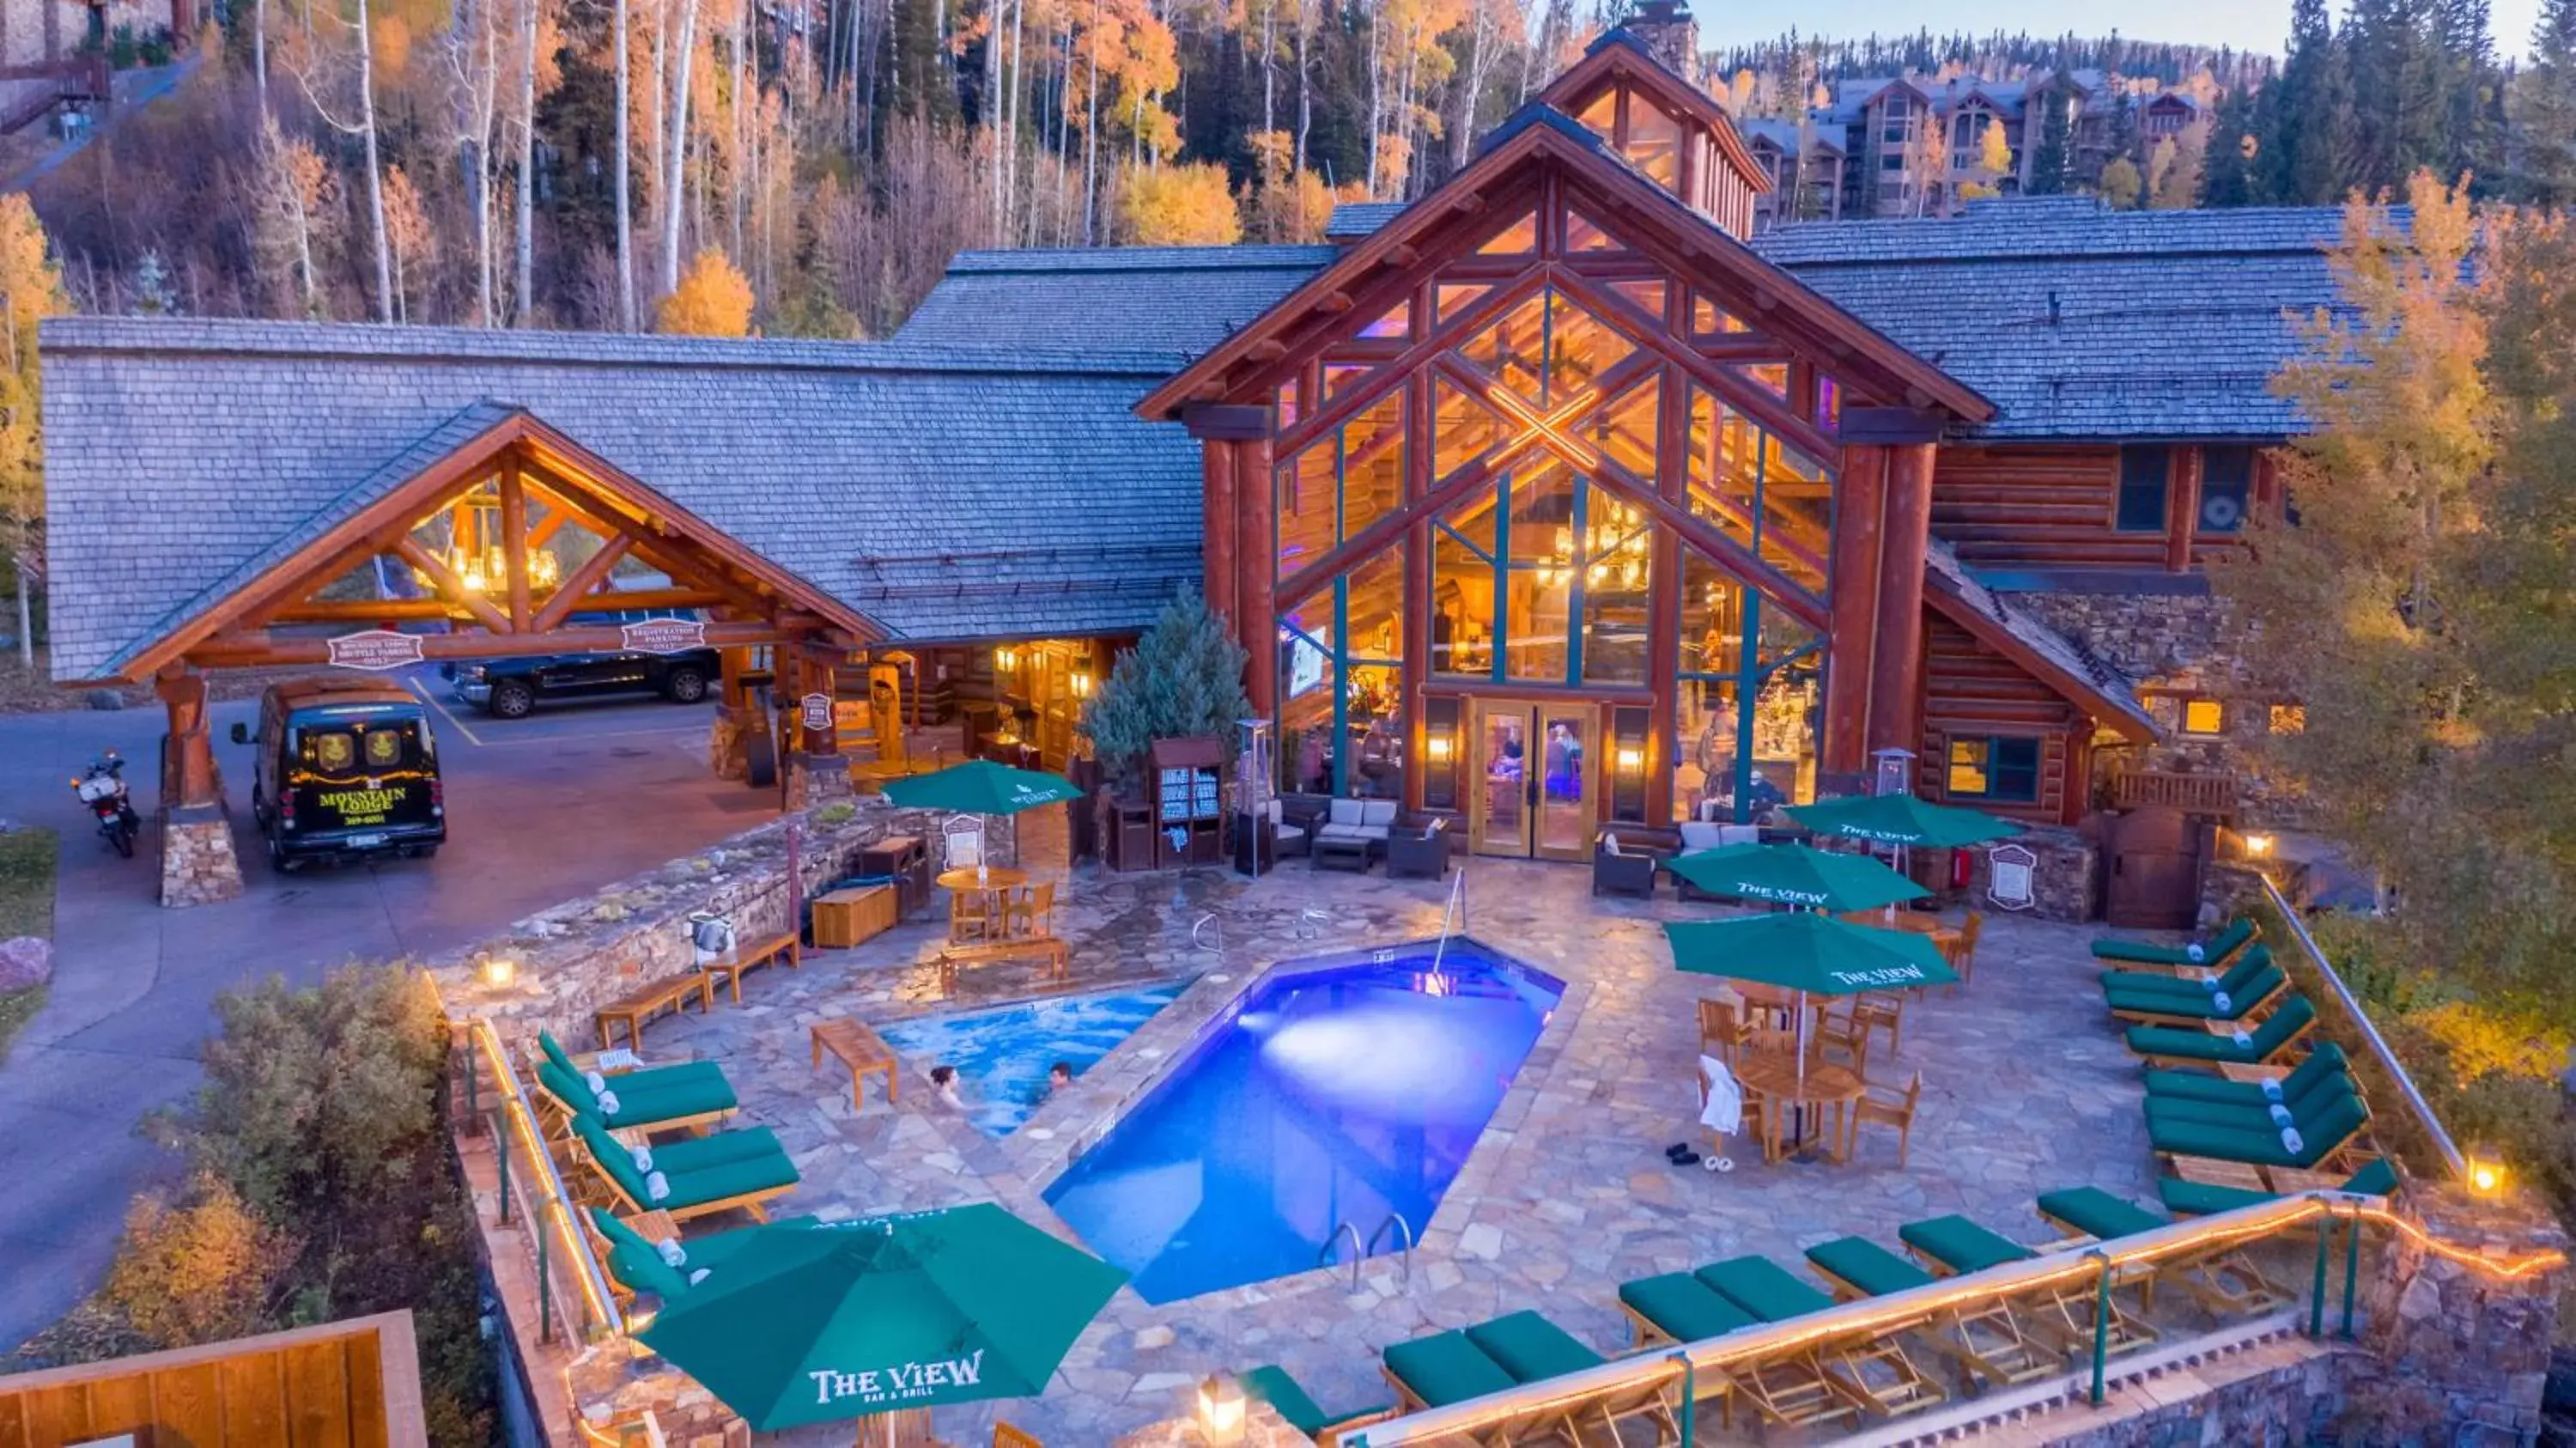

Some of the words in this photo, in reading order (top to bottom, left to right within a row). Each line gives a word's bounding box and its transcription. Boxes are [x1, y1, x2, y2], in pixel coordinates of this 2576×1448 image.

[319, 788, 405, 806] MOUNTAIN
[339, 799, 393, 814] LODGE
[1737, 881, 1773, 897] THE
[1777, 889, 1828, 904] VIEW
[1830, 971, 1869, 985] THE
[1871, 963, 1925, 981] VIEW
[809, 1369, 882, 1404] THE
[886, 1348, 985, 1388] VIEW
[864, 1392, 885, 1403] BAR
[890, 1390, 898, 1401] &
[902, 1386, 935, 1398] GRILL
